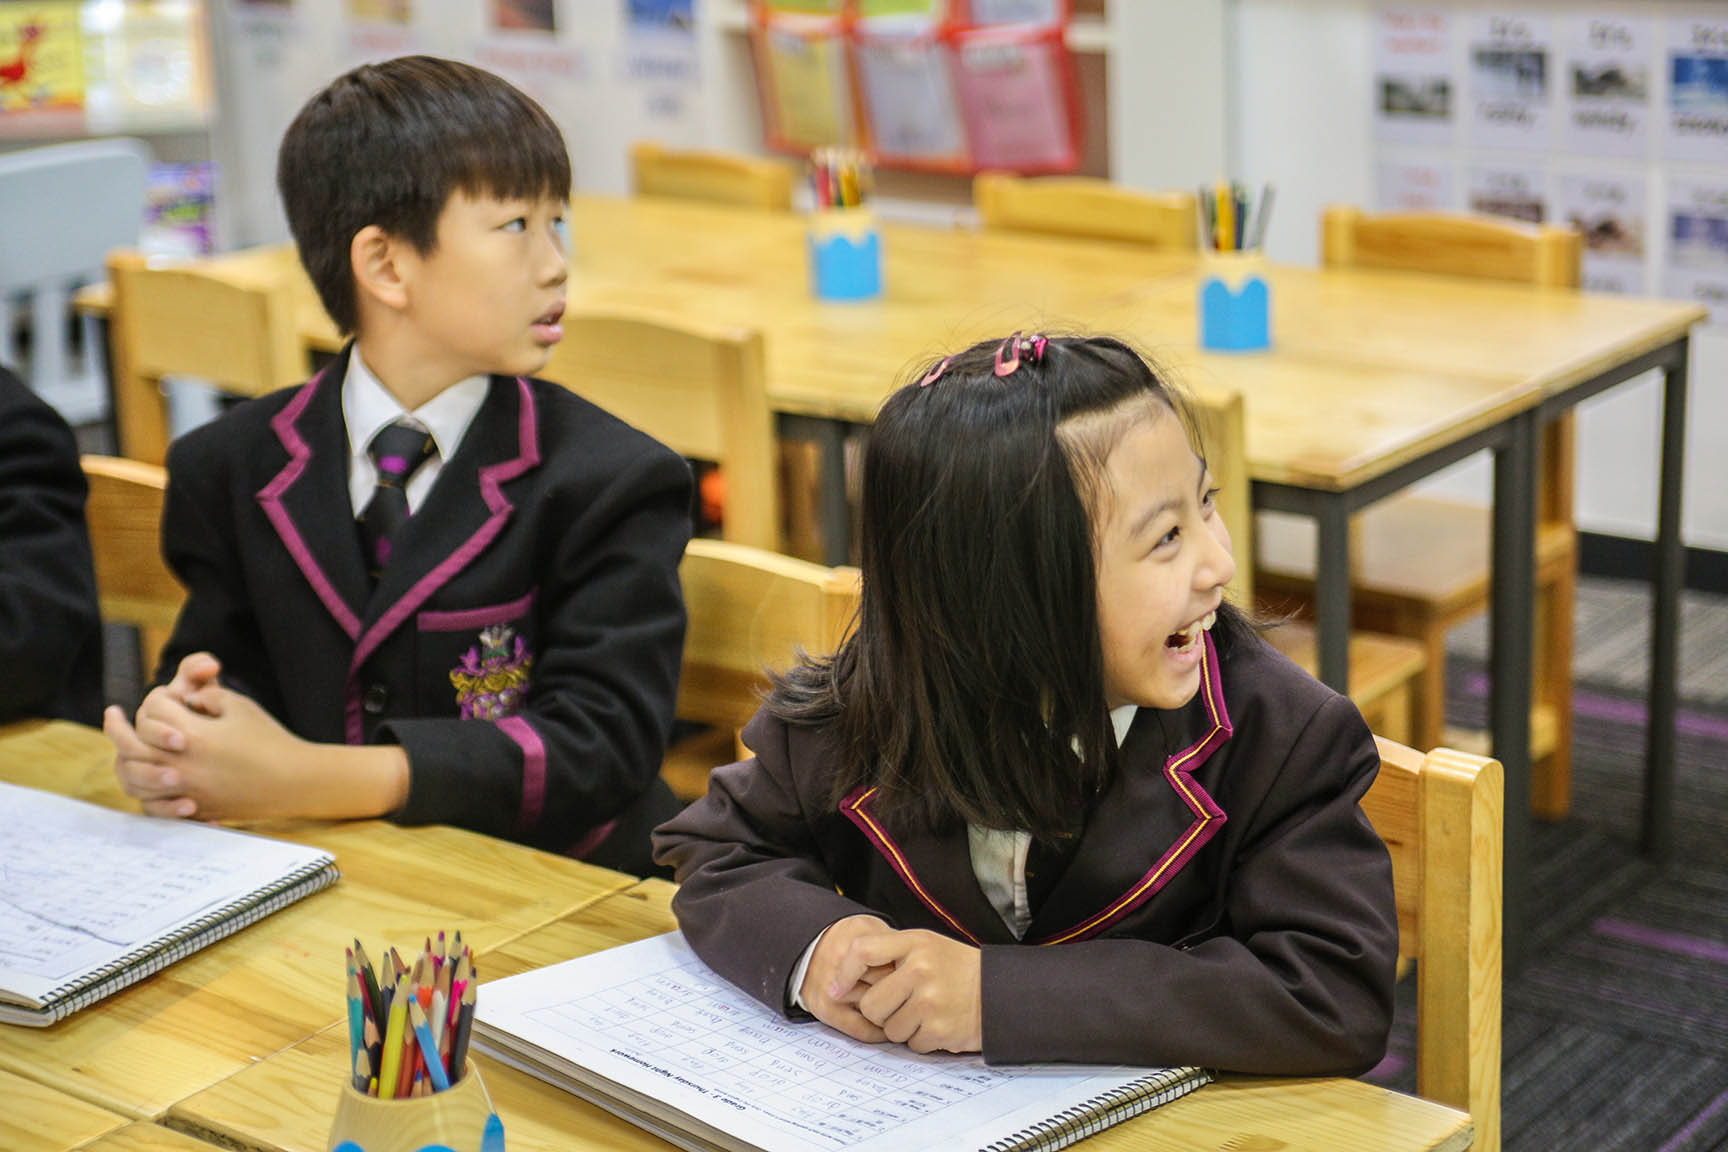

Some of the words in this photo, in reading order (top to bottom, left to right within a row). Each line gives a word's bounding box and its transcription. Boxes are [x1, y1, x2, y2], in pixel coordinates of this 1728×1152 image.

[610, 1048, 652, 1067] Homework
[650, 1066, 675, 1077] Night
[674, 1076, 710, 1094] Thursday
[719, 1097, 748, 1111] Grade
